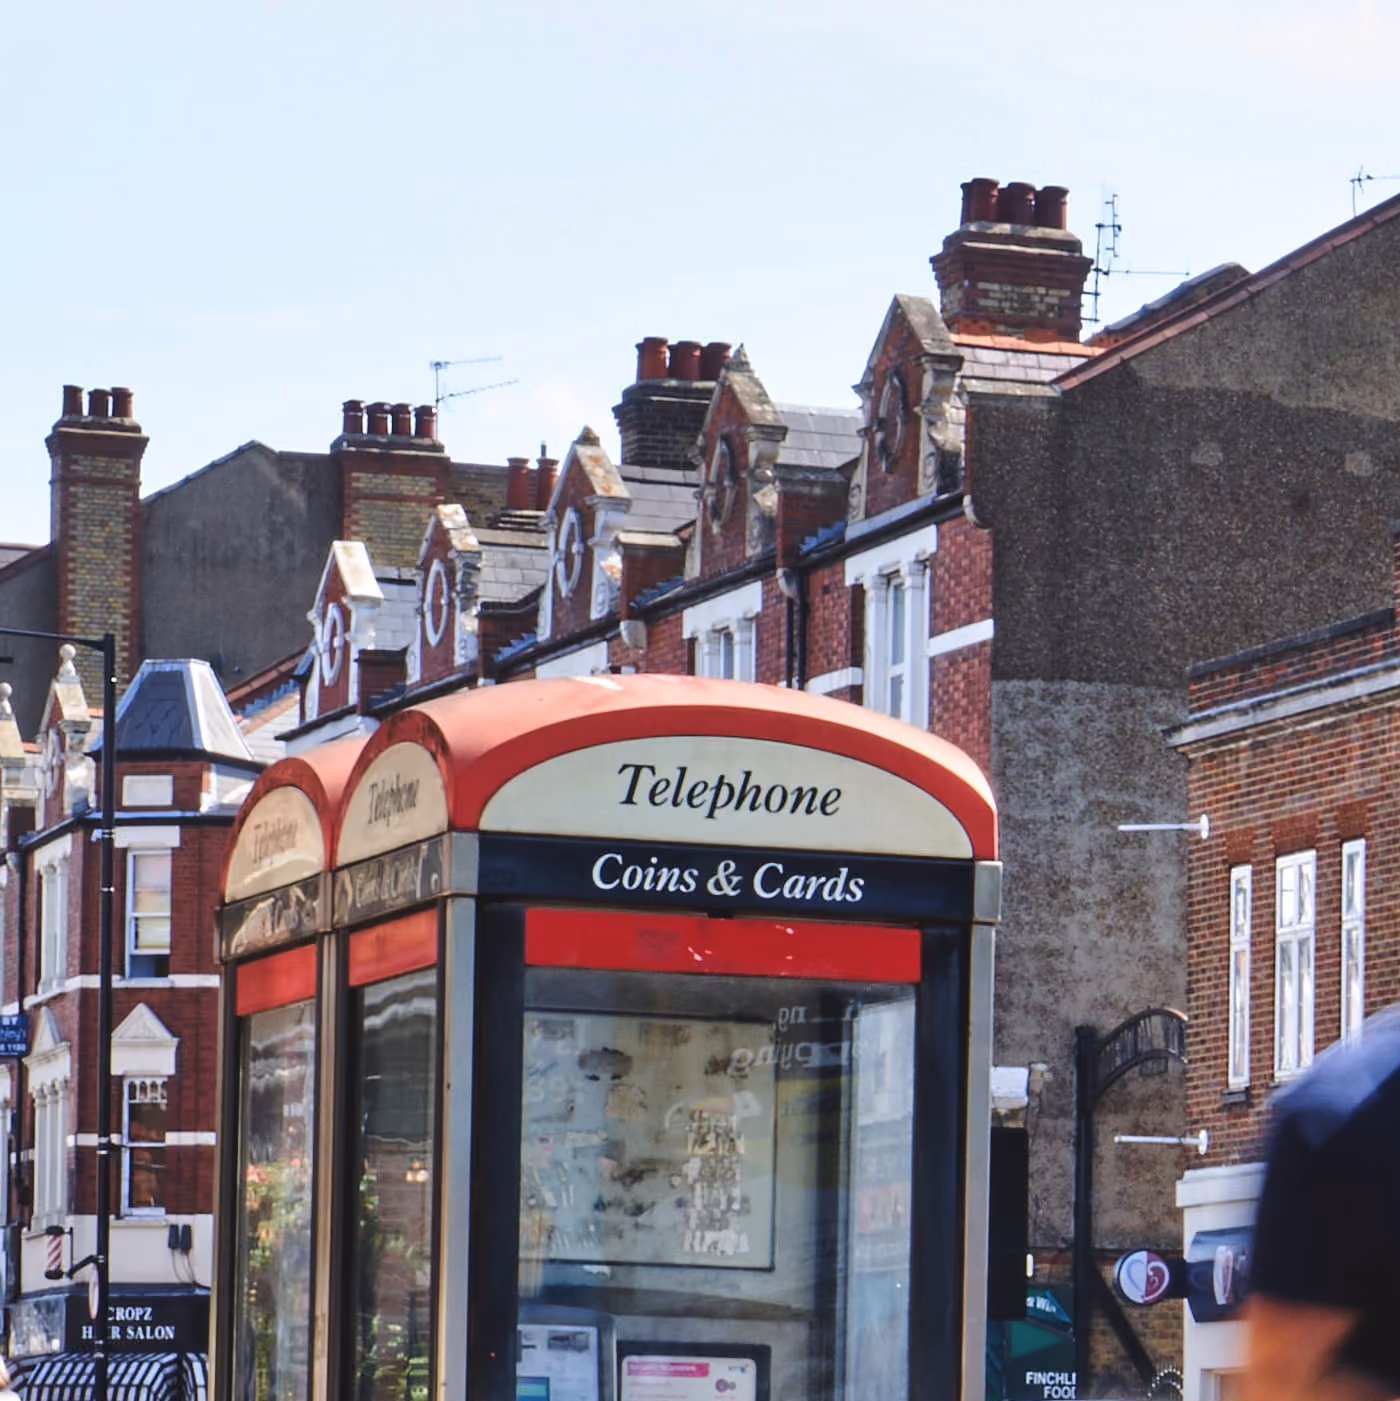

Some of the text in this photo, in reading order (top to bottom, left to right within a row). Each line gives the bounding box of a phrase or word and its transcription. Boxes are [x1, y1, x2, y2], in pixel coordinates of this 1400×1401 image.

[617, 763, 842, 820] Telephone
[591, 853, 865, 904] Coins & Cards
[127, 1325, 175, 1339] SALON
